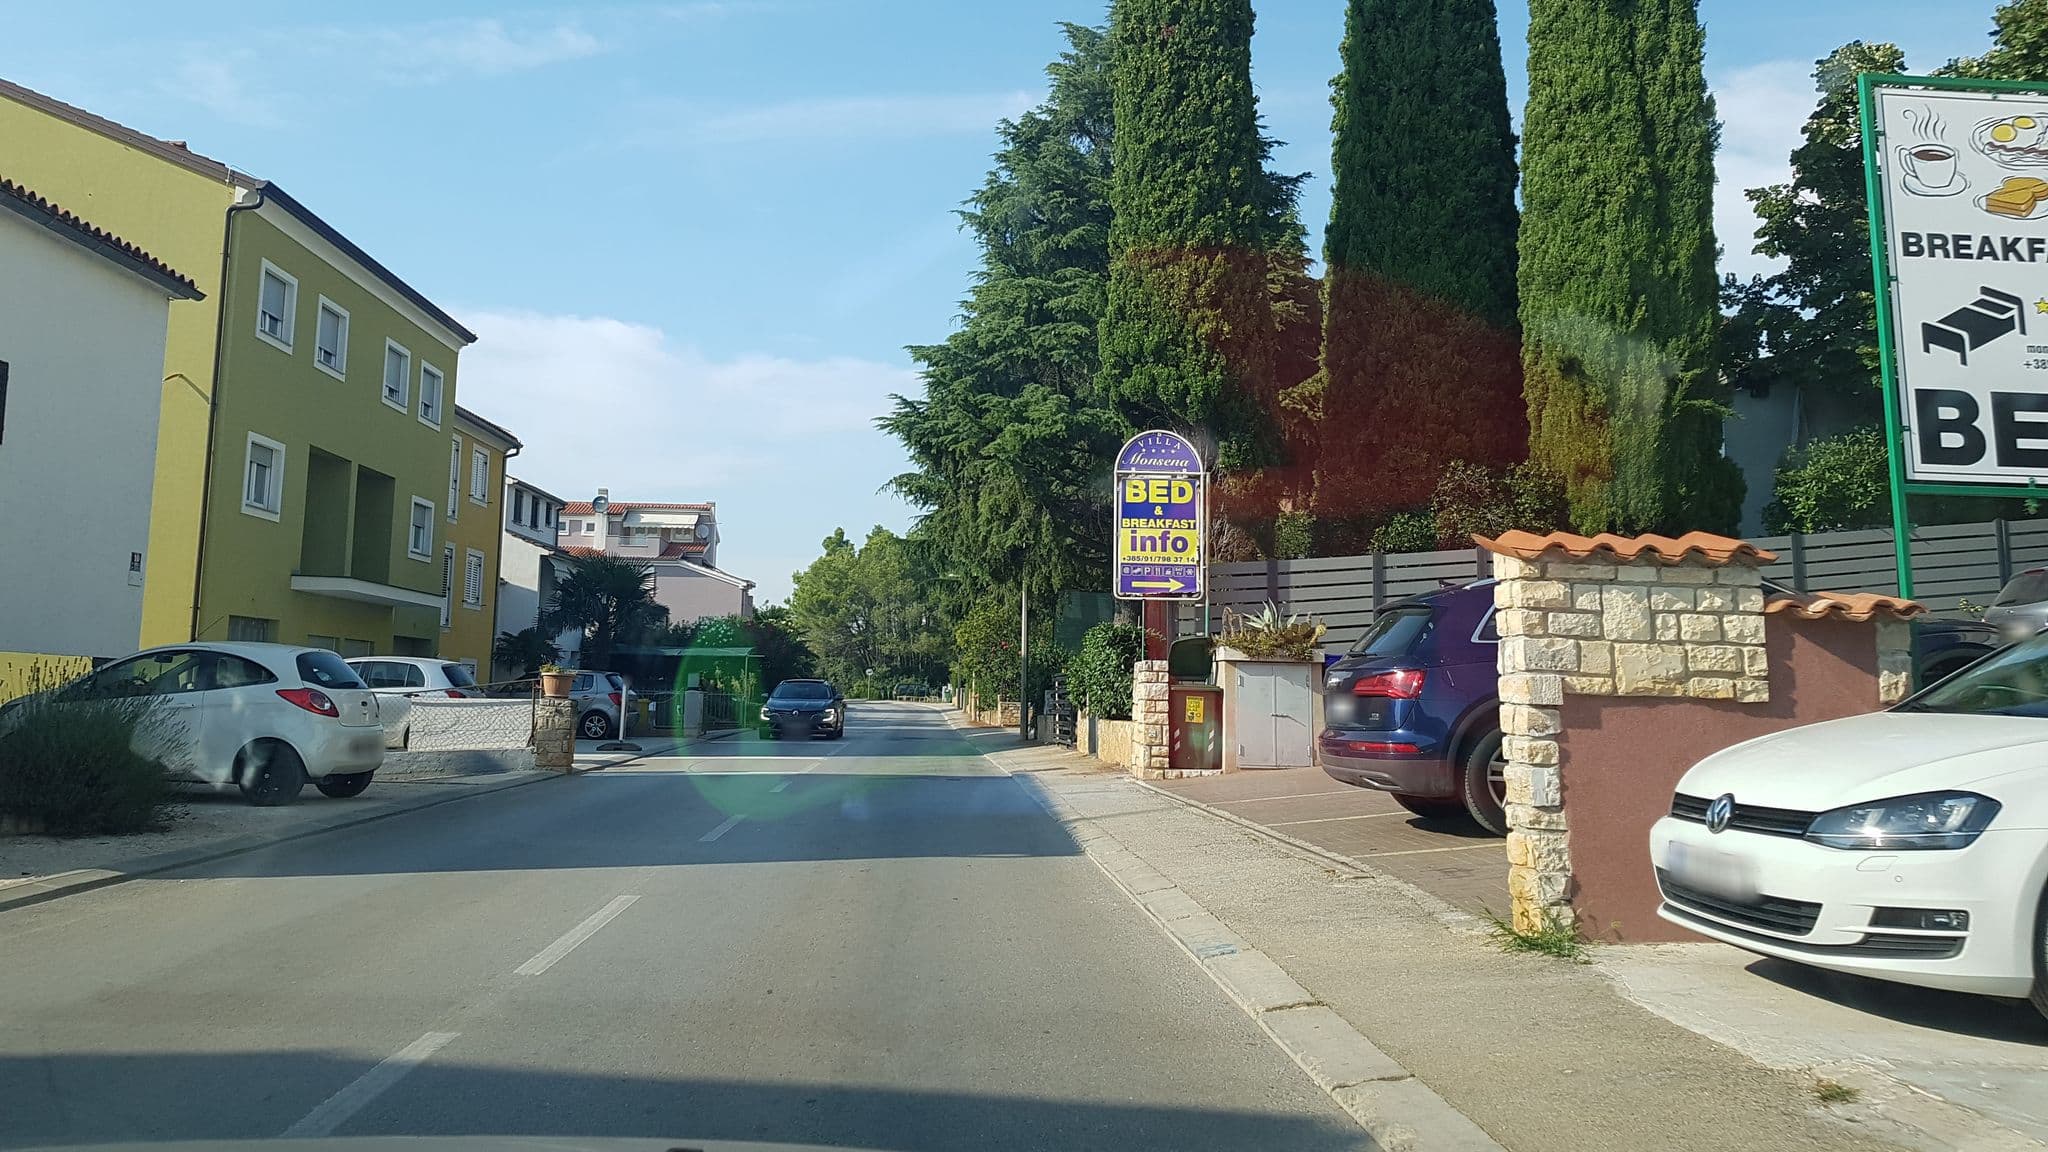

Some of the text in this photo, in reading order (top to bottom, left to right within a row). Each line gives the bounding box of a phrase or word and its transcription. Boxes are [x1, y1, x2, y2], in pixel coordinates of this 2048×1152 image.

[1901, 231, 2048, 263] BREAKF
[2023, 358, 2048, 370] +38
[1138, 437, 1181, 450] VILLA
[1121, 452, 1189, 467] Monsena
[1126, 479, 1193, 504] BED
[1154, 505, 1163, 516] &
[1122, 518, 1196, 529] BREAKFAST
[1130, 529, 1189, 553] info
